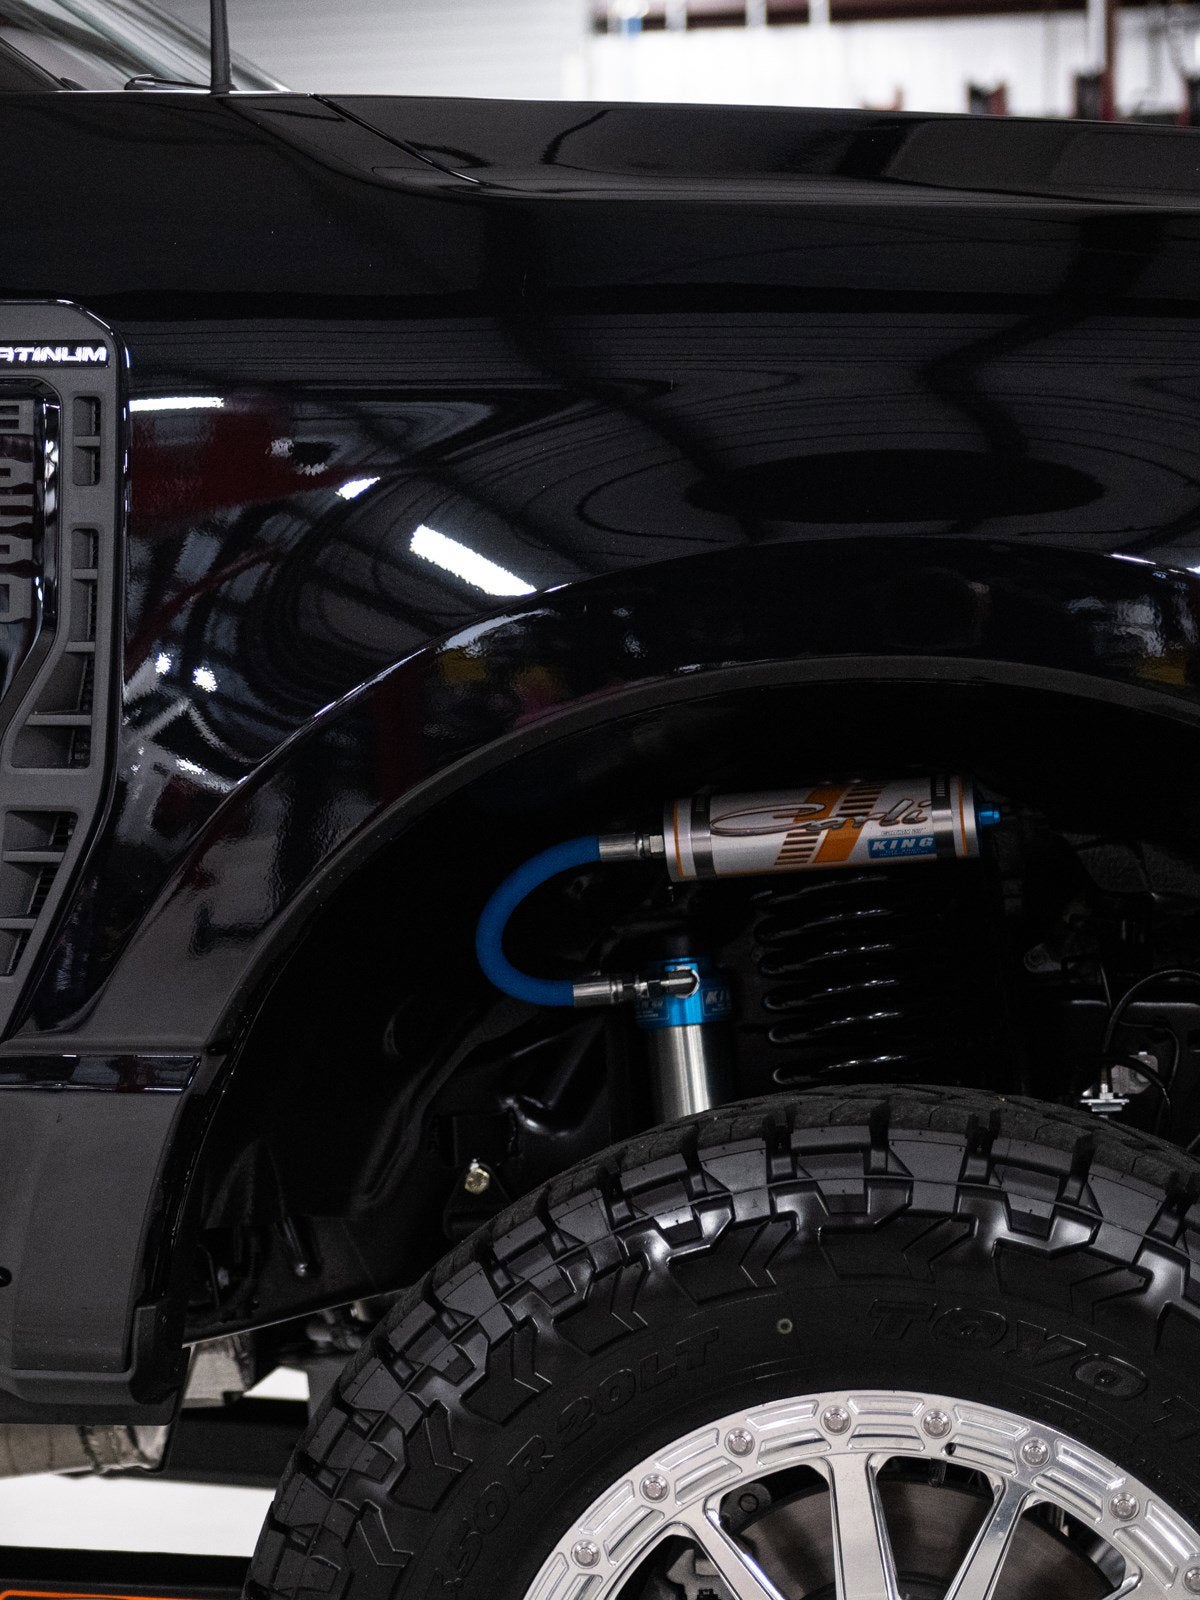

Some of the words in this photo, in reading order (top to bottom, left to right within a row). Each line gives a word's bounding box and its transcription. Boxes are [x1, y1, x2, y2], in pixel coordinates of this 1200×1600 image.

[710, 799, 932, 837] Carli
[872, 837, 934, 851] KING
[868, 1299, 1149, 1398] TOYO
